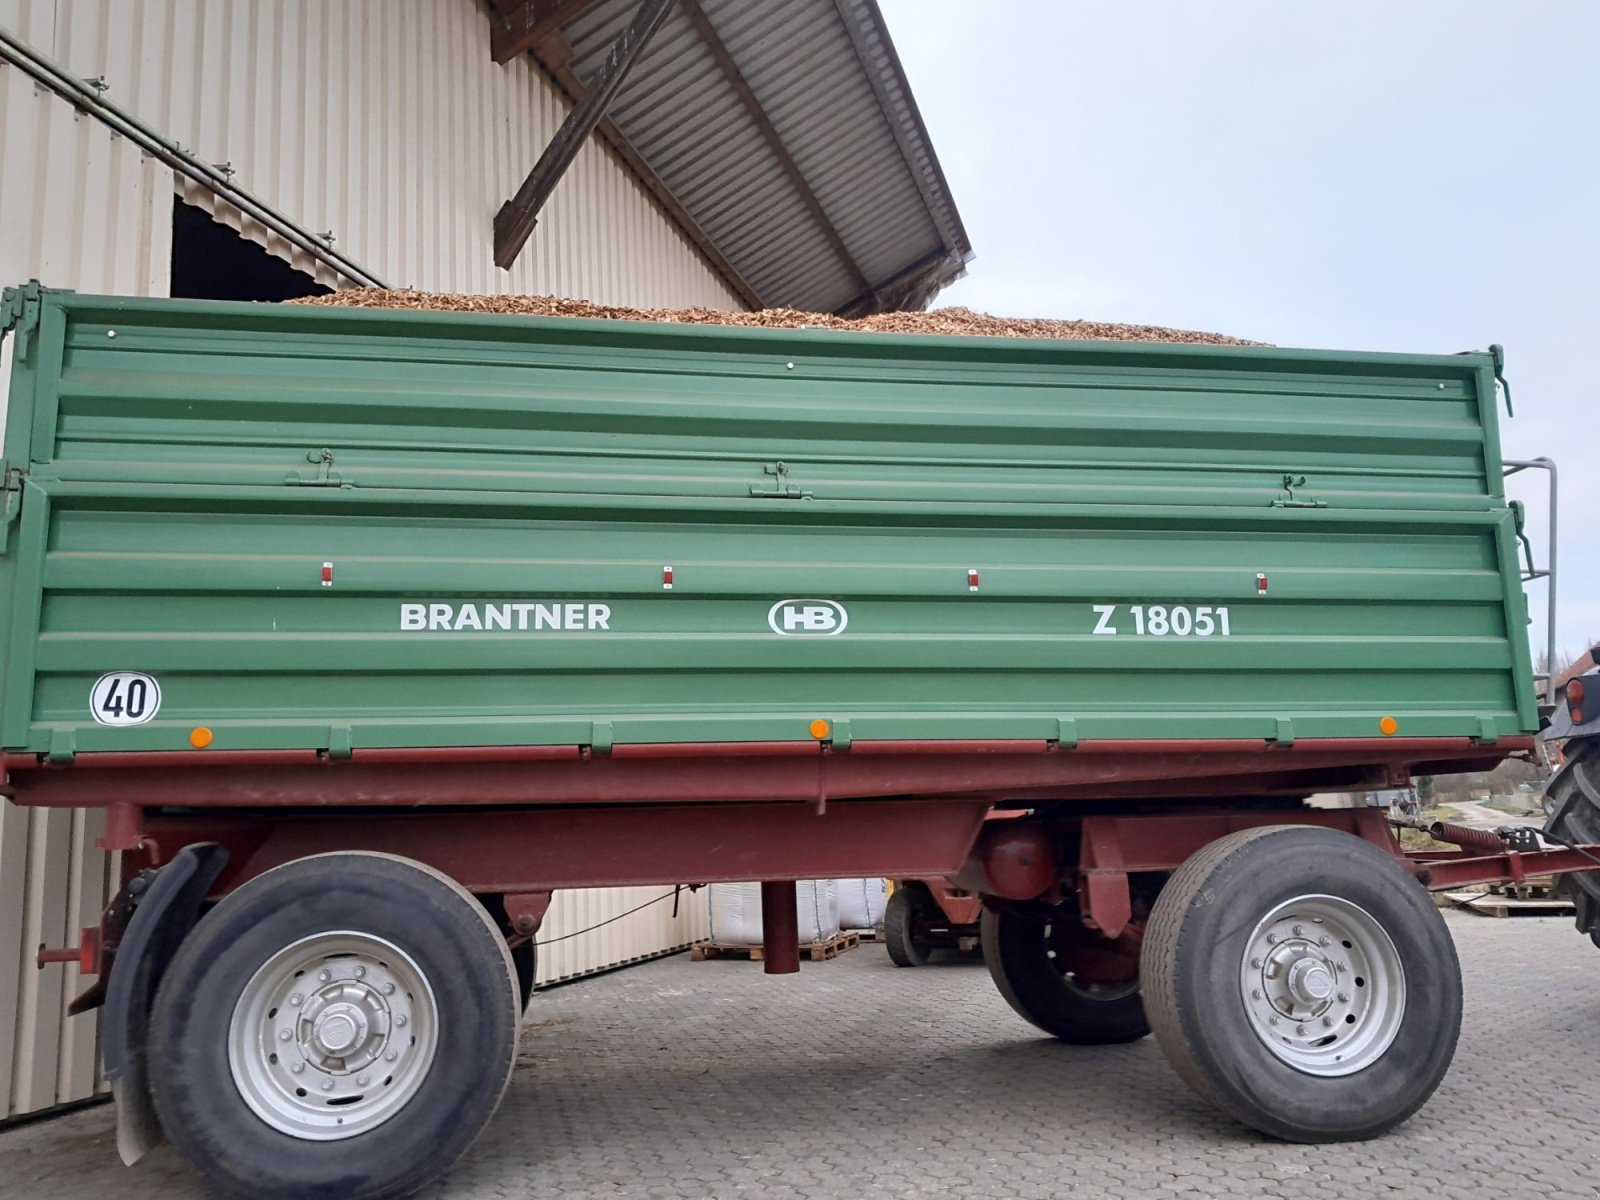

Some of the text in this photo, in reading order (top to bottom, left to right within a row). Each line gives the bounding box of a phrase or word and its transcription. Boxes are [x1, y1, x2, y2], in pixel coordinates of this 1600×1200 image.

[400, 603, 611, 631] BRANTNER
[782, 605, 837, 631] HB
[1092, 605, 1230, 636] Z 18051
[102, 678, 147, 718] 40
